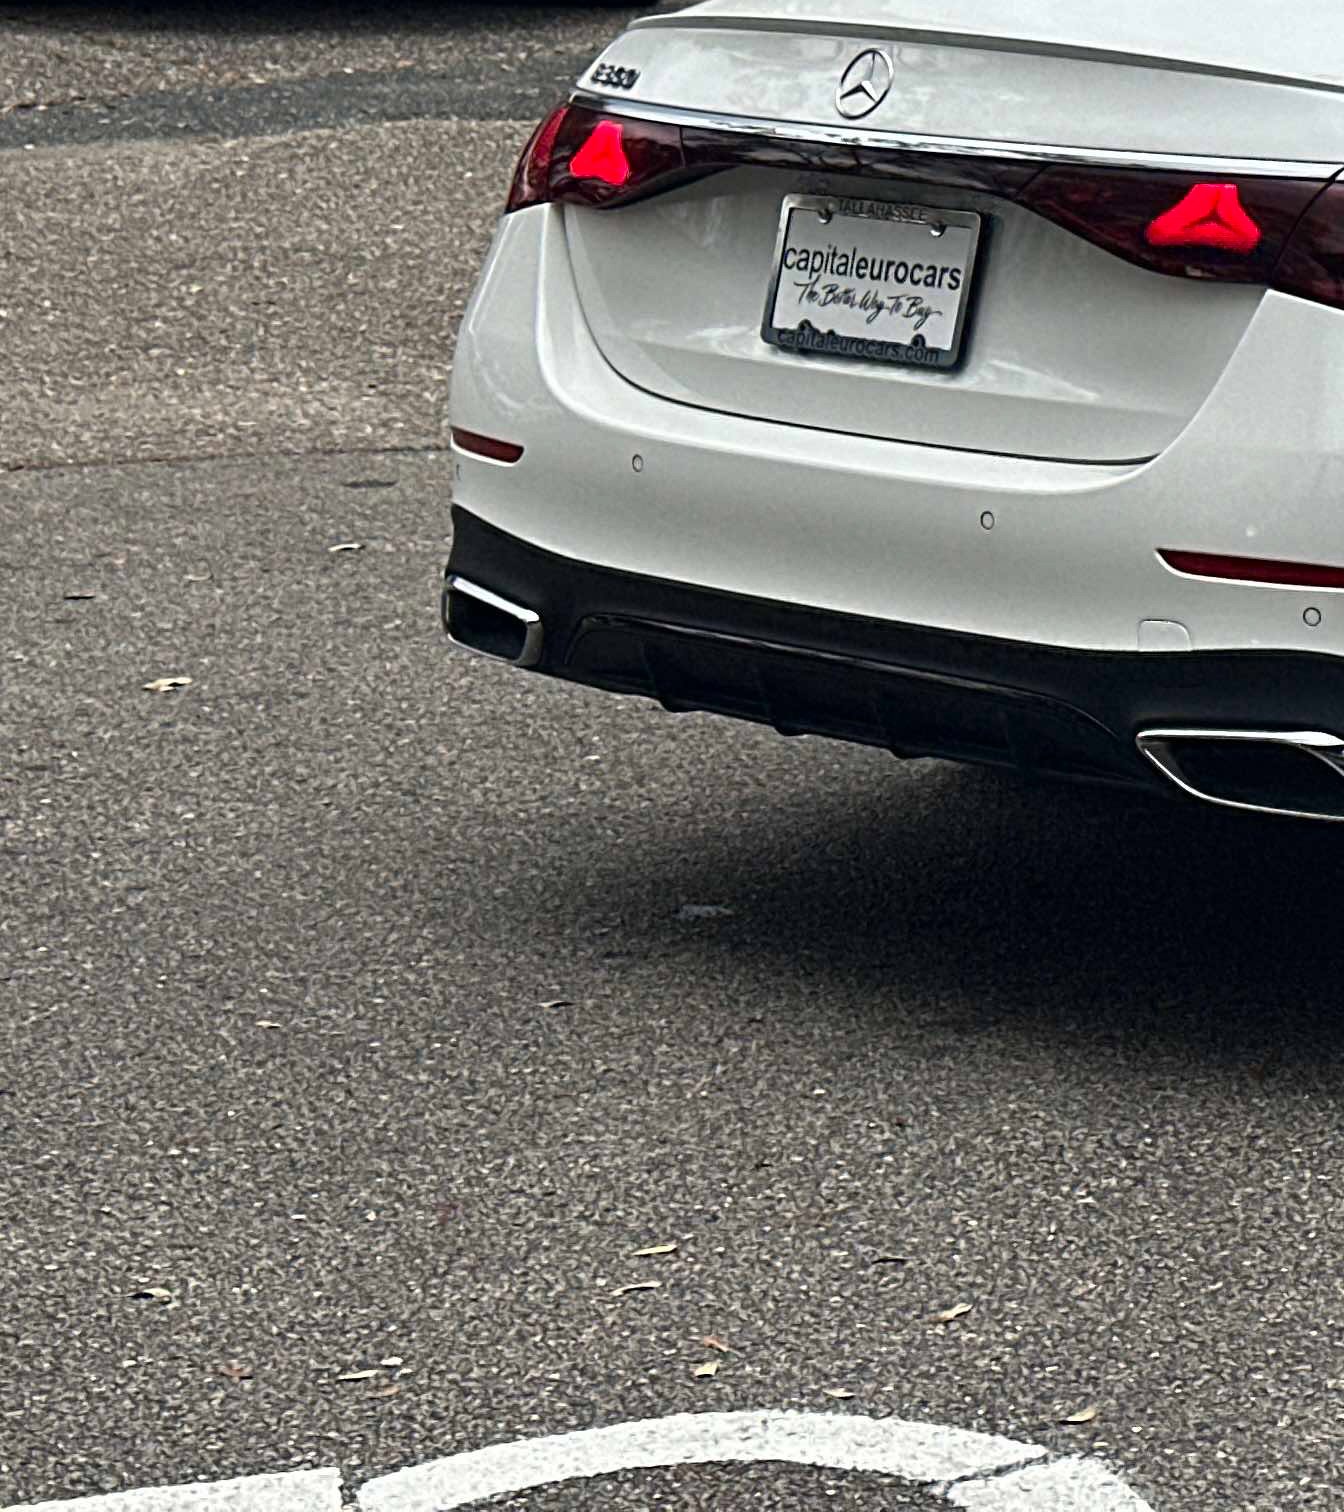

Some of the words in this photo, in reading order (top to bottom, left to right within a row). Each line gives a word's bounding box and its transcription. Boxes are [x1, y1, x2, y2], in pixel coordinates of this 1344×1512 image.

[838, 198, 929, 220] TALLAHASSEE
[783, 245, 962, 291] capitaleurocars
[793, 274, 821, 303] The
[777, 327, 940, 364] capitaleurocars.com
